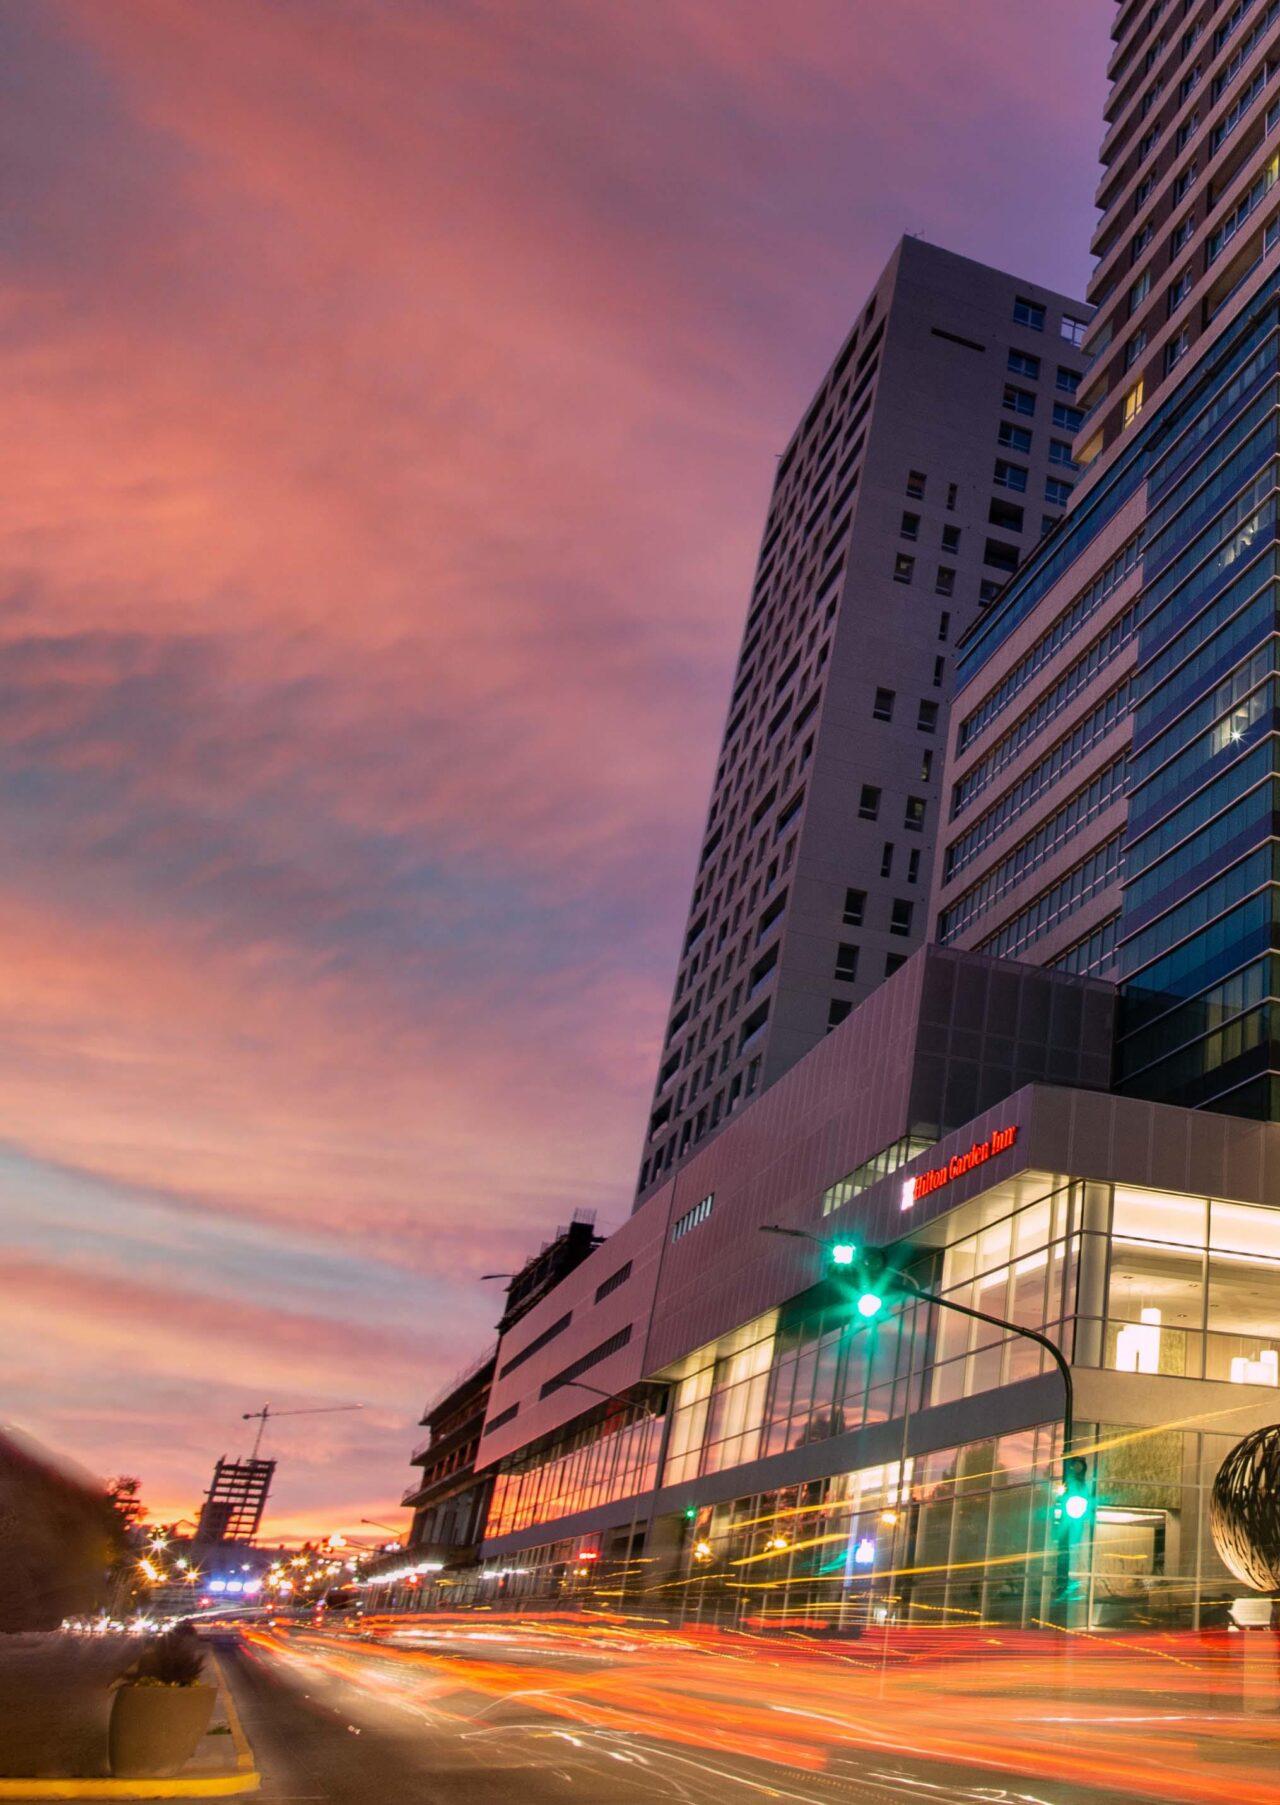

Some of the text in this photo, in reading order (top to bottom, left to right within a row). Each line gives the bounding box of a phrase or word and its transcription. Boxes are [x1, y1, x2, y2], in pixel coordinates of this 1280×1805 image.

[914, 1125, 1018, 1201] Hilton Garden Inn
